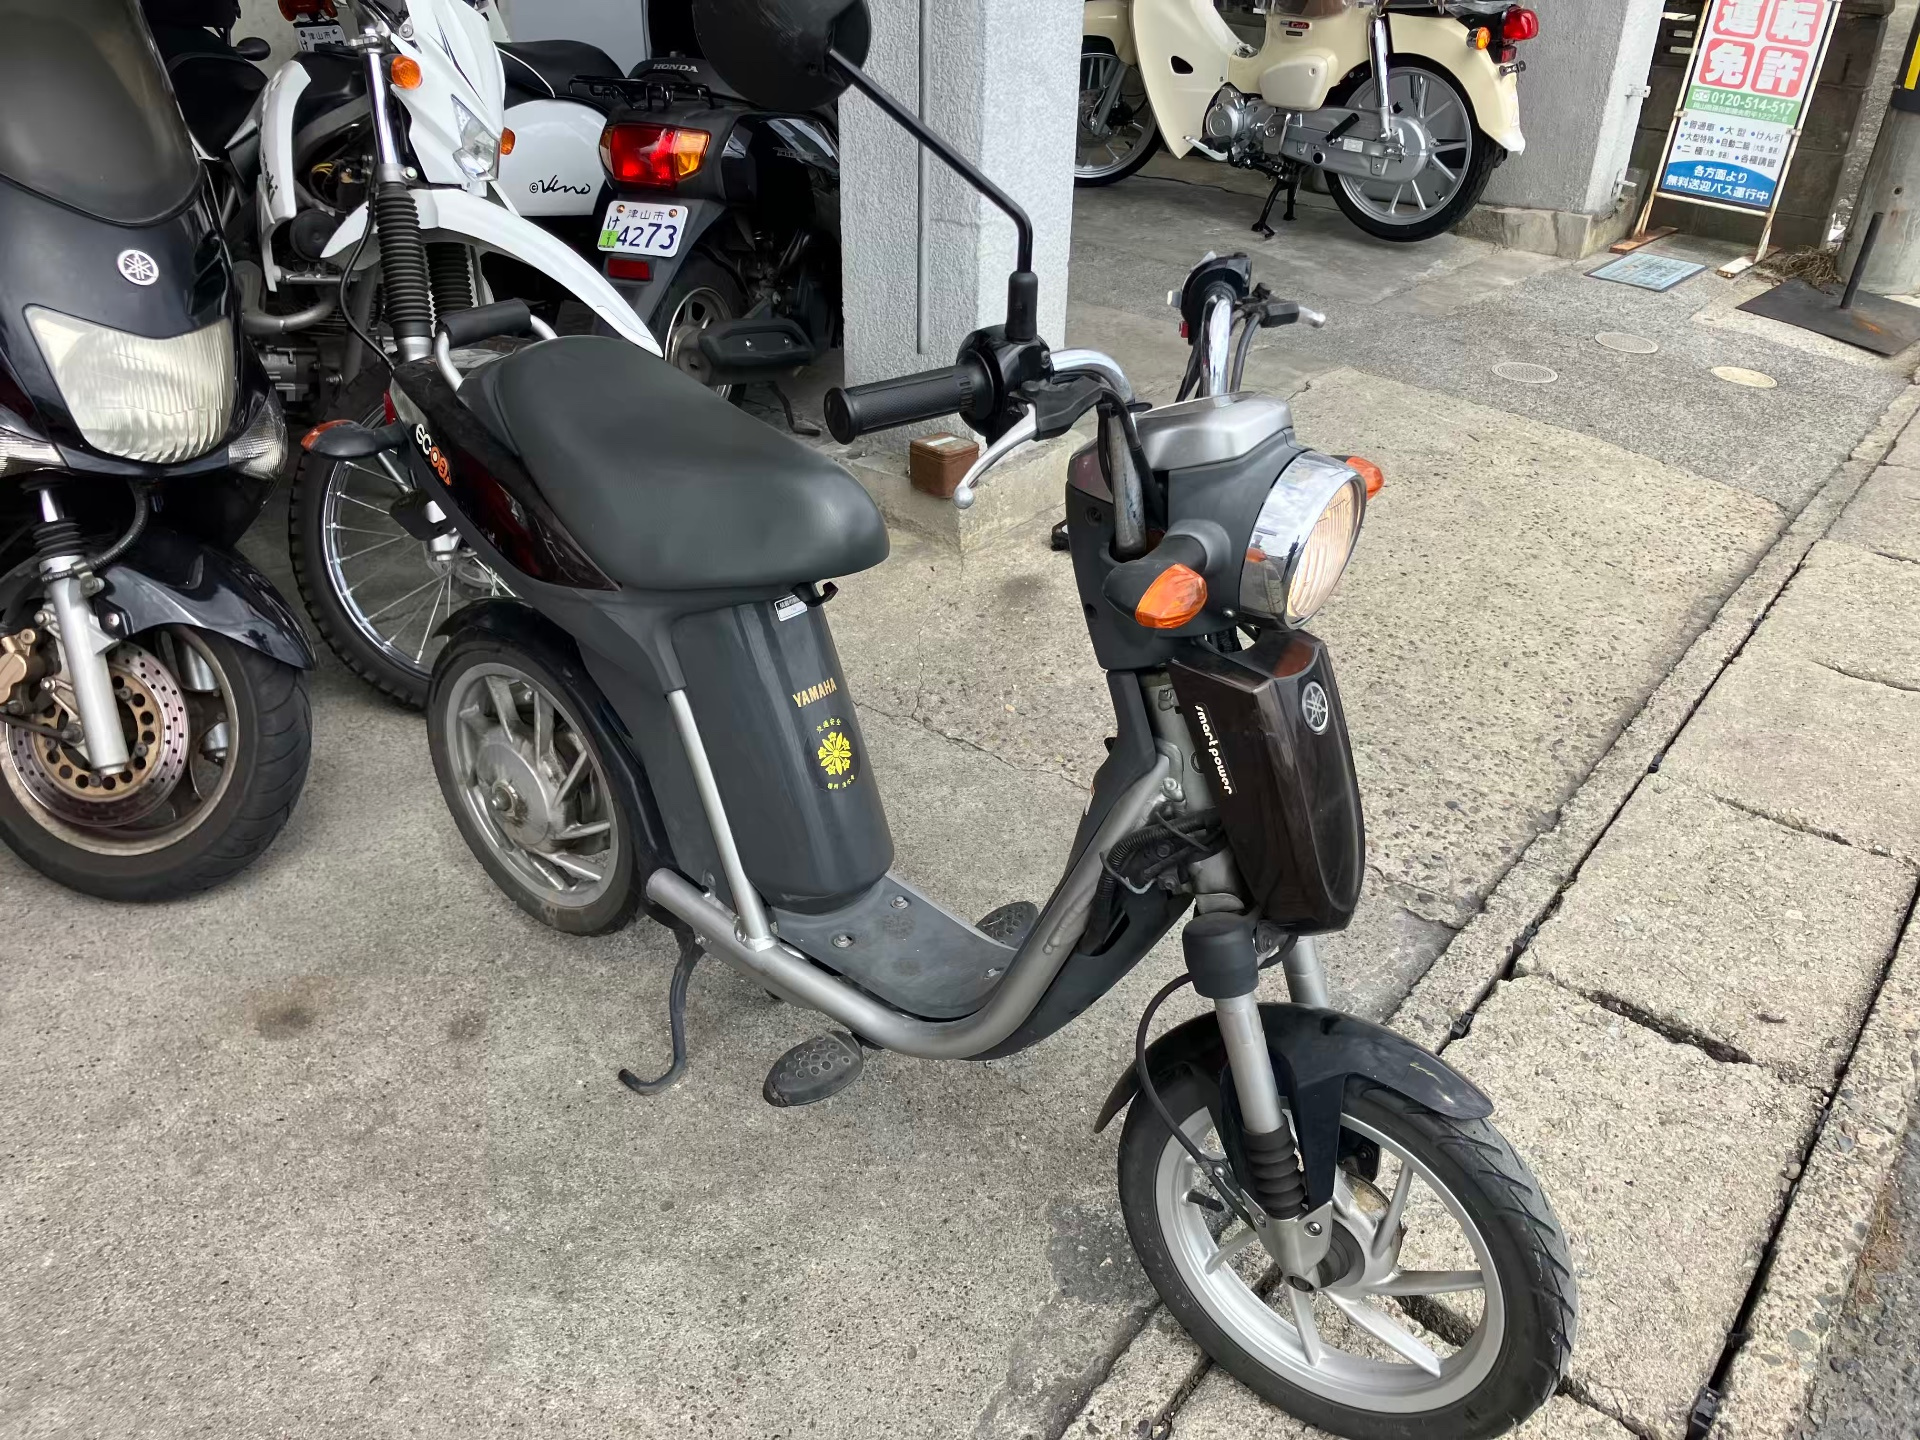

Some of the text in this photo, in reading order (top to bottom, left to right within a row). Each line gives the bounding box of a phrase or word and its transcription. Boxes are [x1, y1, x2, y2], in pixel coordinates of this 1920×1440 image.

[653, 63, 699, 73] HONDA
[1705, 42, 1803, 93] 免許
[1711, 91, 1795, 115] 0120-514-517
[1756, 131, 1783, 143] けん引
[1694, 165, 1748, 183] 各方面より
[1666, 174, 1769, 202] 無料送迎バス運行中
[607, 215, 620, 230] け
[627, 209, 665, 221] 津山市
[617, 222, 678, 250] 4273
[792, 677, 838, 708] YAMAHA
[1194, 704, 1233, 795] smart power
